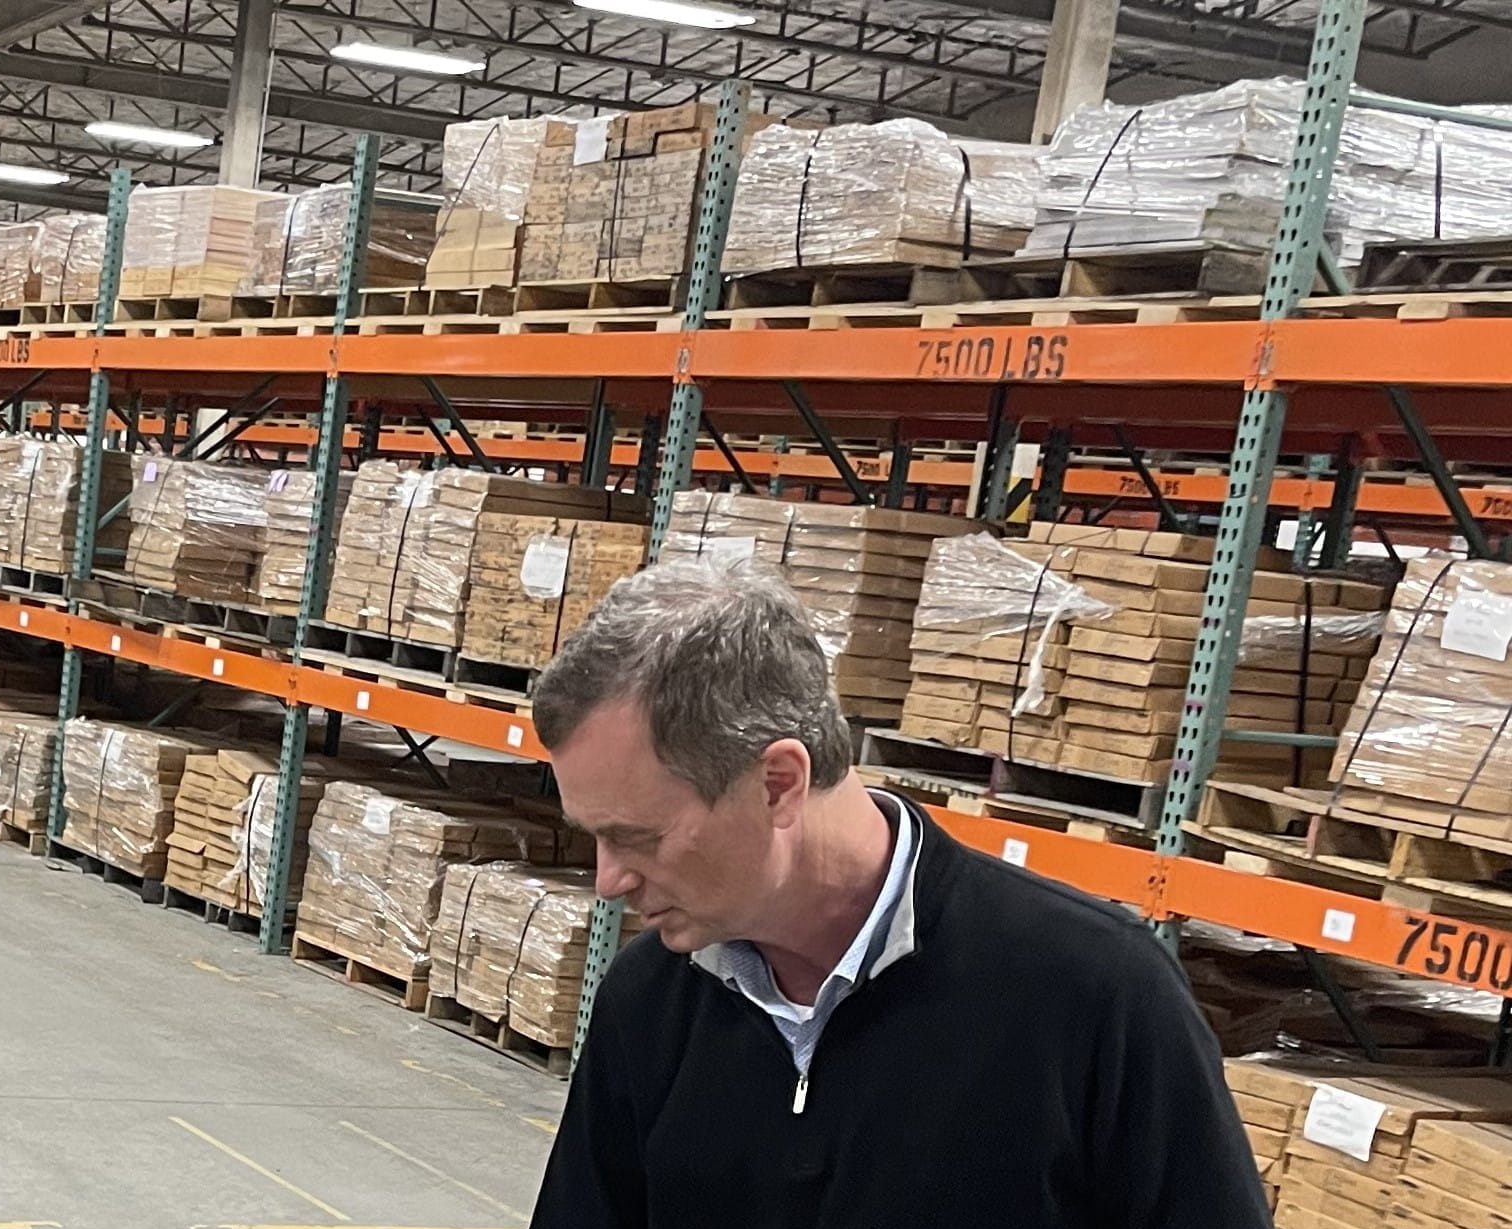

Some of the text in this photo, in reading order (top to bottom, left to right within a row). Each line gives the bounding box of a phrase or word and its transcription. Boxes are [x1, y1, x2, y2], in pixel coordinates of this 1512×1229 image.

[916, 335, 1068, 379] 7500 LBS
[1396, 916, 1512, 991] 7500
